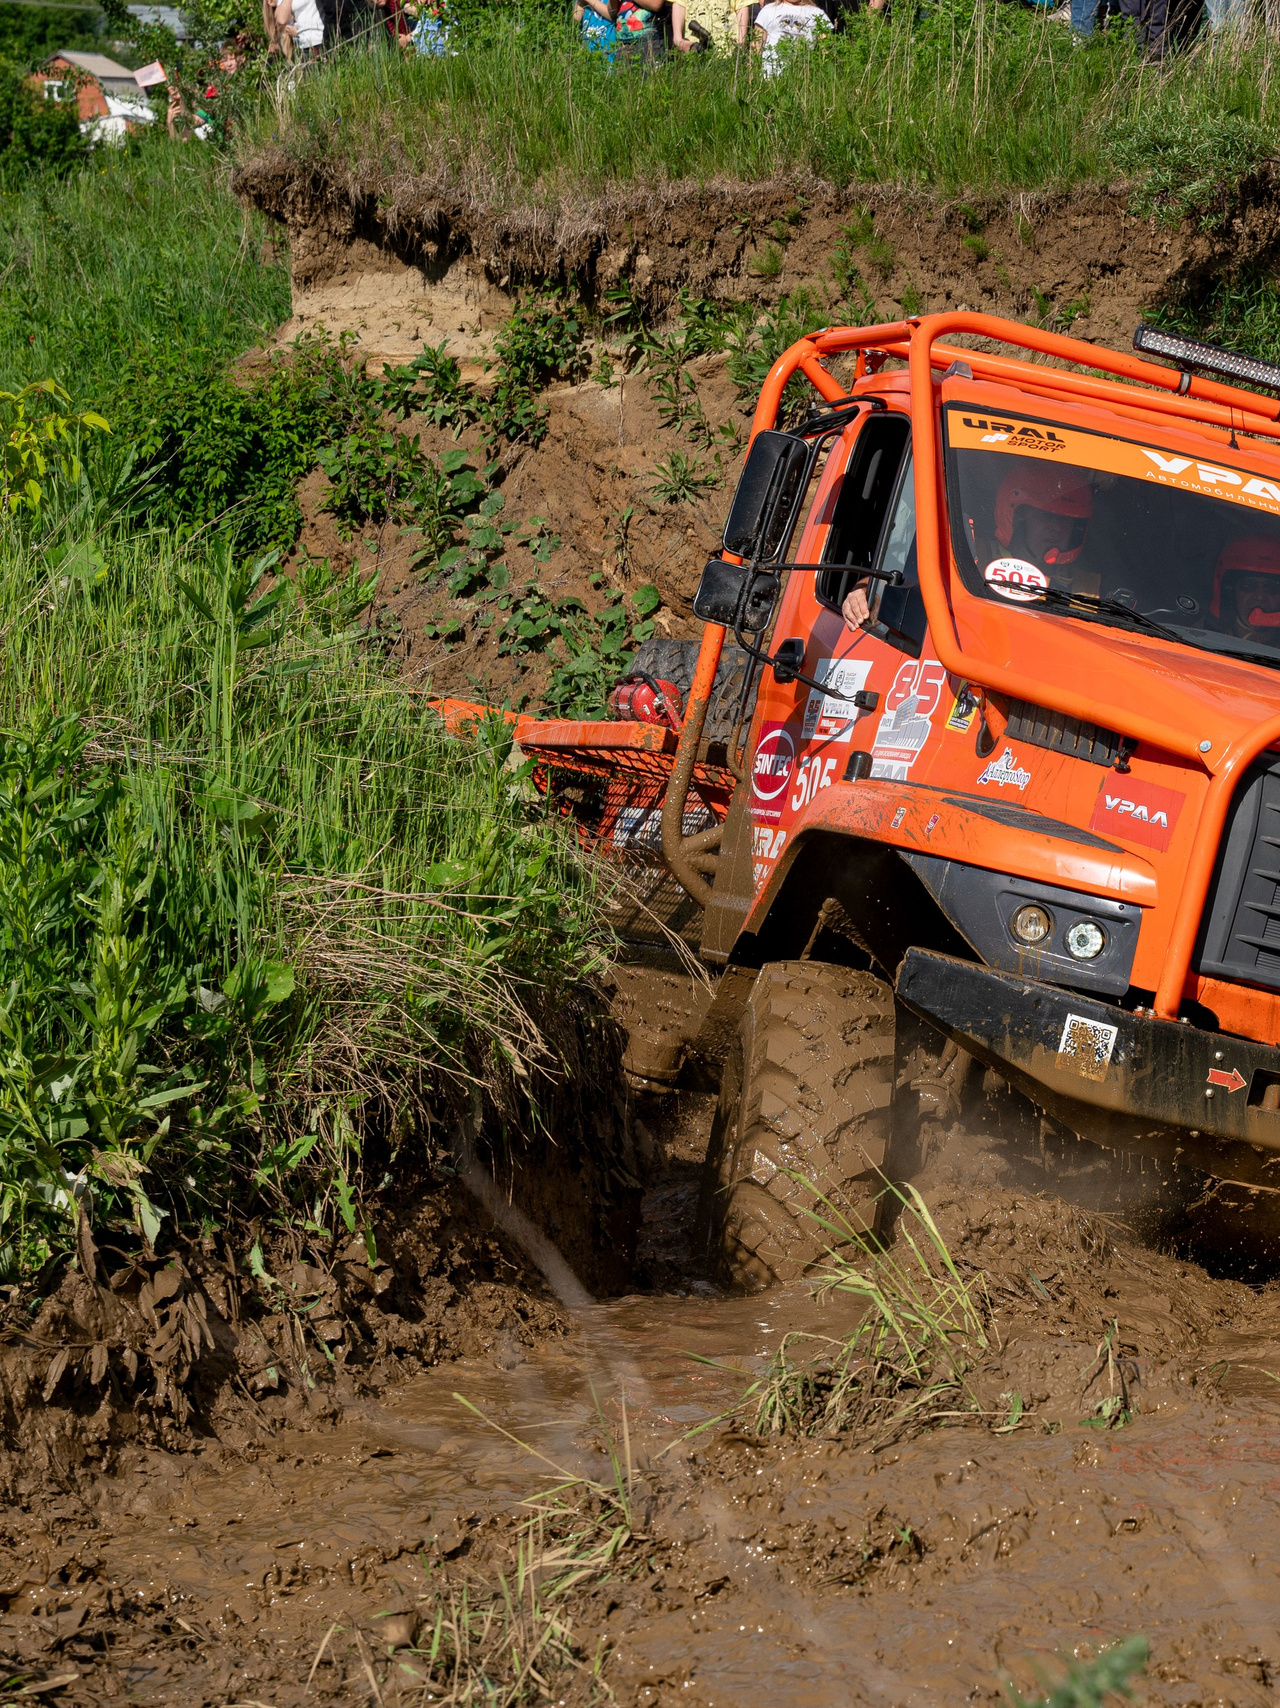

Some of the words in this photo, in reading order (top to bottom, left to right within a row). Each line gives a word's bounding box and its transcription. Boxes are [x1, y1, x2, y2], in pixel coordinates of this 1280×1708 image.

[962, 418, 1065, 443] URAL
[1007, 440, 1060, 453] SPORT
[1011, 436, 1066, 449] MOTOR
[991, 567, 1041, 590] 505
[886, 662, 944, 714] 85
[753, 753, 792, 777] SINTEC
[871, 763, 906, 781] РАЛ
[1104, 794, 1168, 828] УРАЛ
